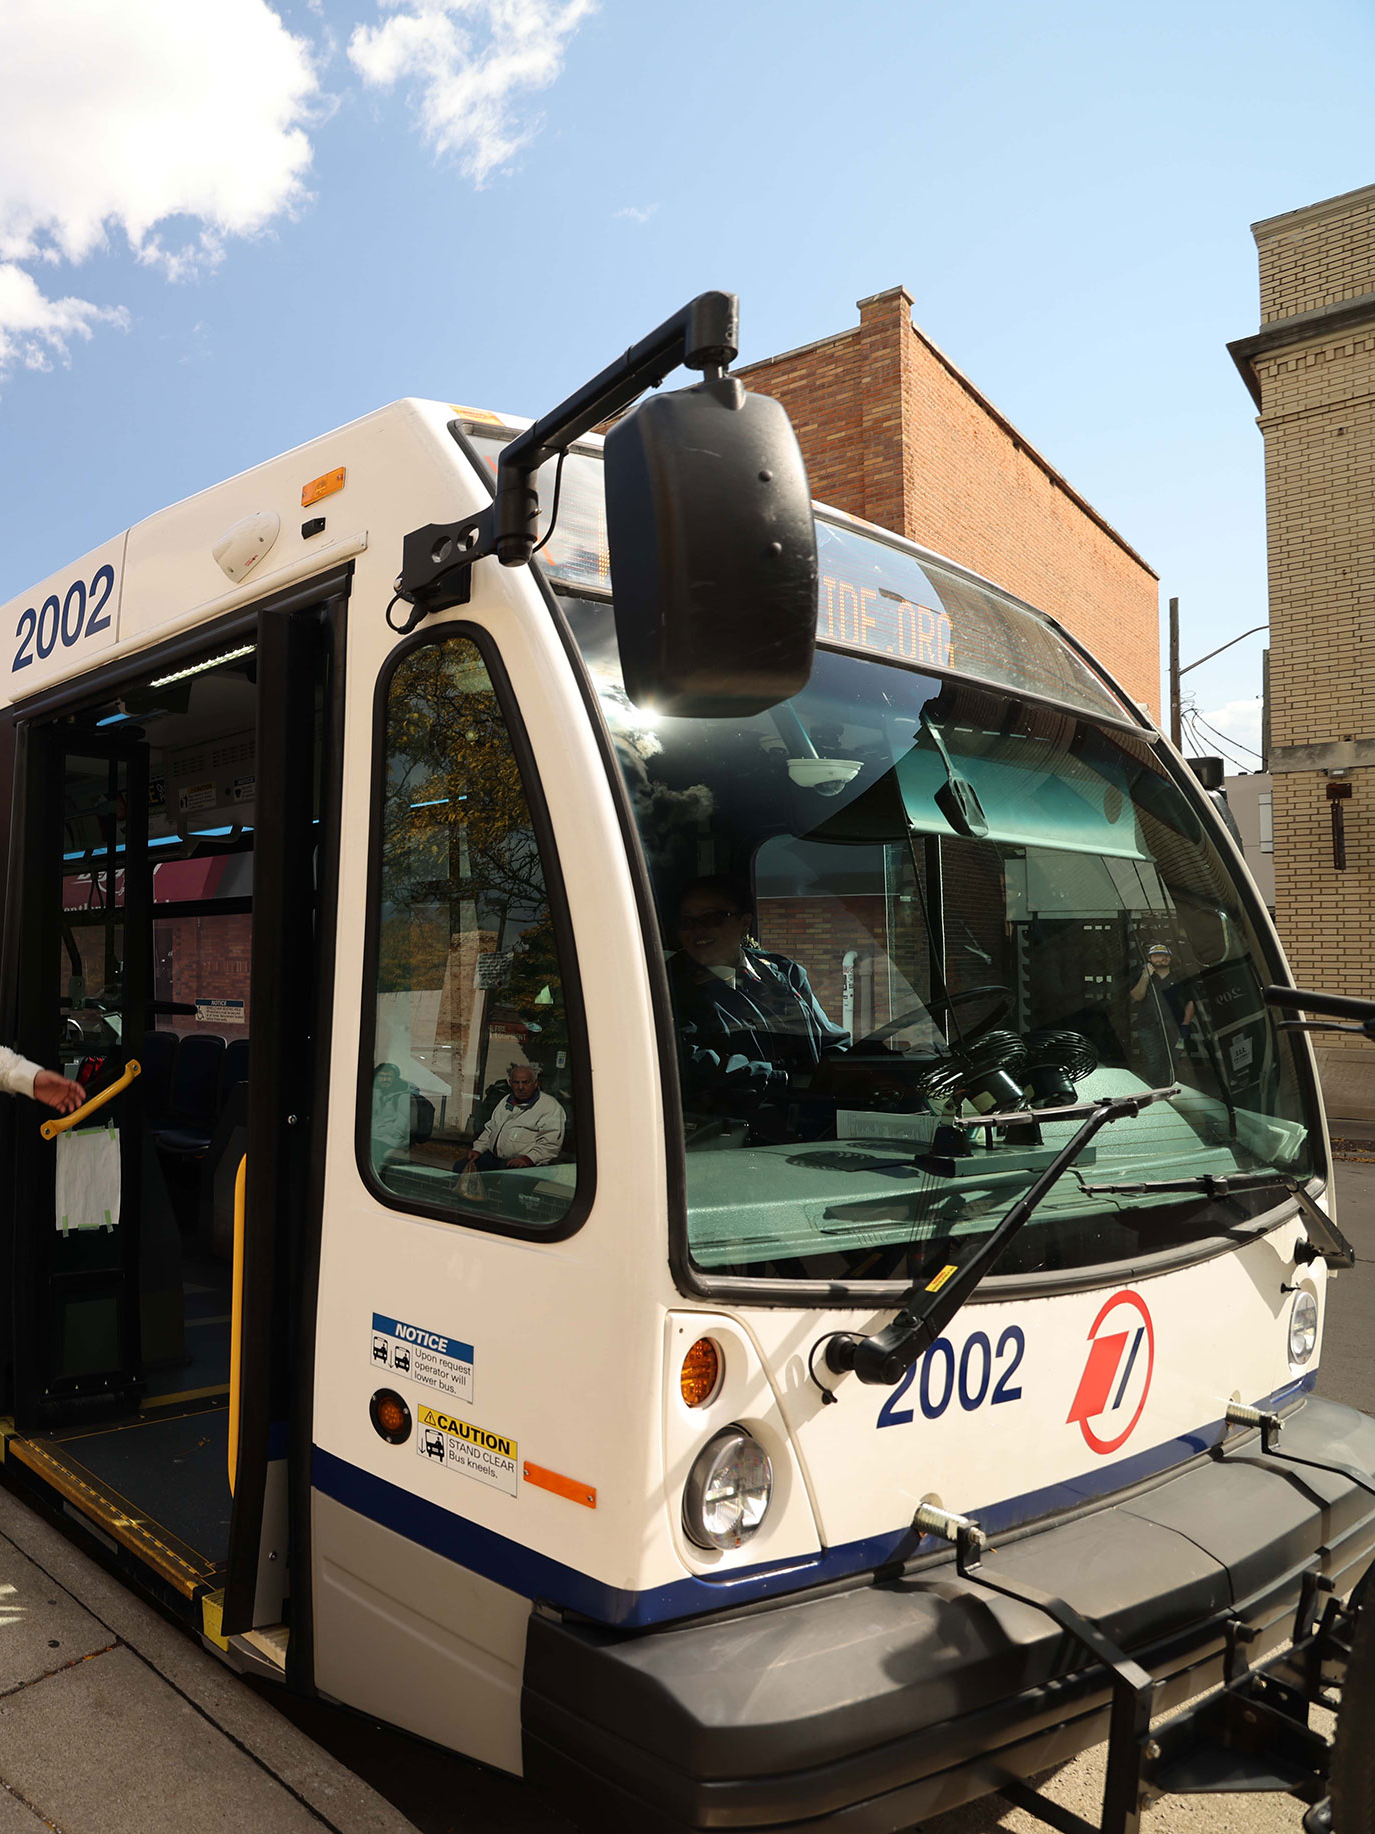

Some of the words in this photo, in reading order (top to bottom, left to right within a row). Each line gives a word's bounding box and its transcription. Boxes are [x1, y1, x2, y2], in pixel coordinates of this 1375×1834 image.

[12, 564, 115, 673] 2002
[395, 1324, 449, 1353] NOTICE
[414, 1361, 449, 1380] operator
[450, 1373, 466, 1386] will
[415, 1348, 437, 1364] Upon
[439, 1356, 471, 1376] request
[414, 1372, 437, 1387] lower
[439, 1377, 457, 1394] bus.
[876, 1325, 1025, 1429] 2002
[437, 1415, 510, 1455] CAUTION
[448, 1438, 481, 1459] STAND
[483, 1452, 515, 1473] CLEAR
[448, 1450, 465, 1465] Bus
[467, 1459, 498, 1479] kneels.
